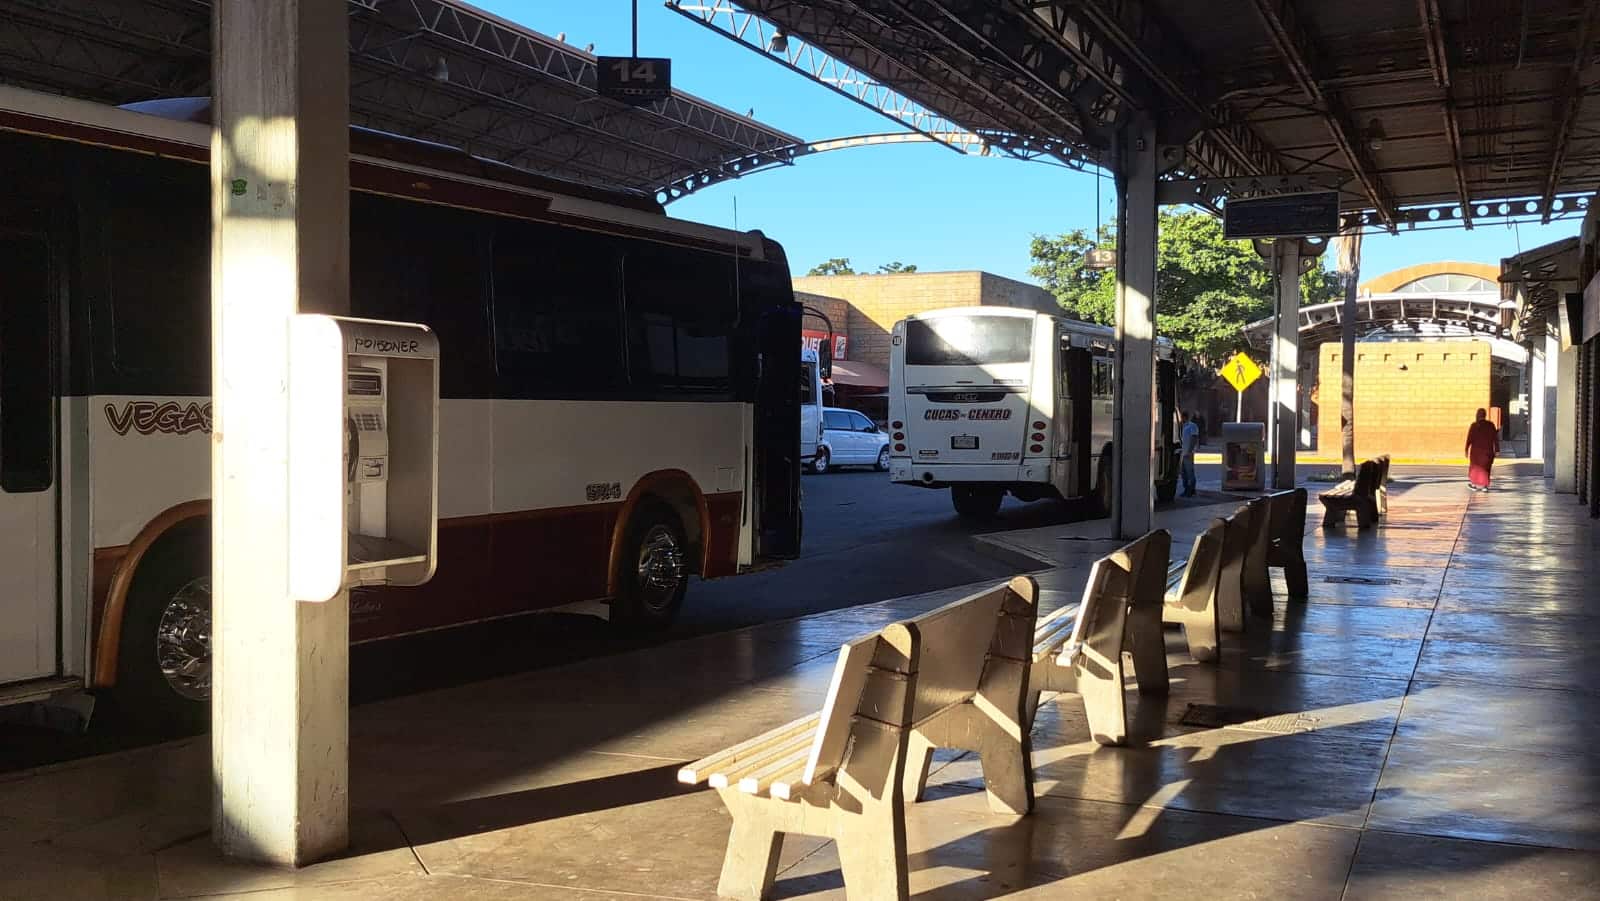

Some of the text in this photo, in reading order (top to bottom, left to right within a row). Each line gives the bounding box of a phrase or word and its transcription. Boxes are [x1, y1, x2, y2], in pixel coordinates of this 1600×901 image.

[610, 60, 657, 82] 14
[1091, 249, 1112, 262] 13
[968, 408, 1012, 421] CENTRO
